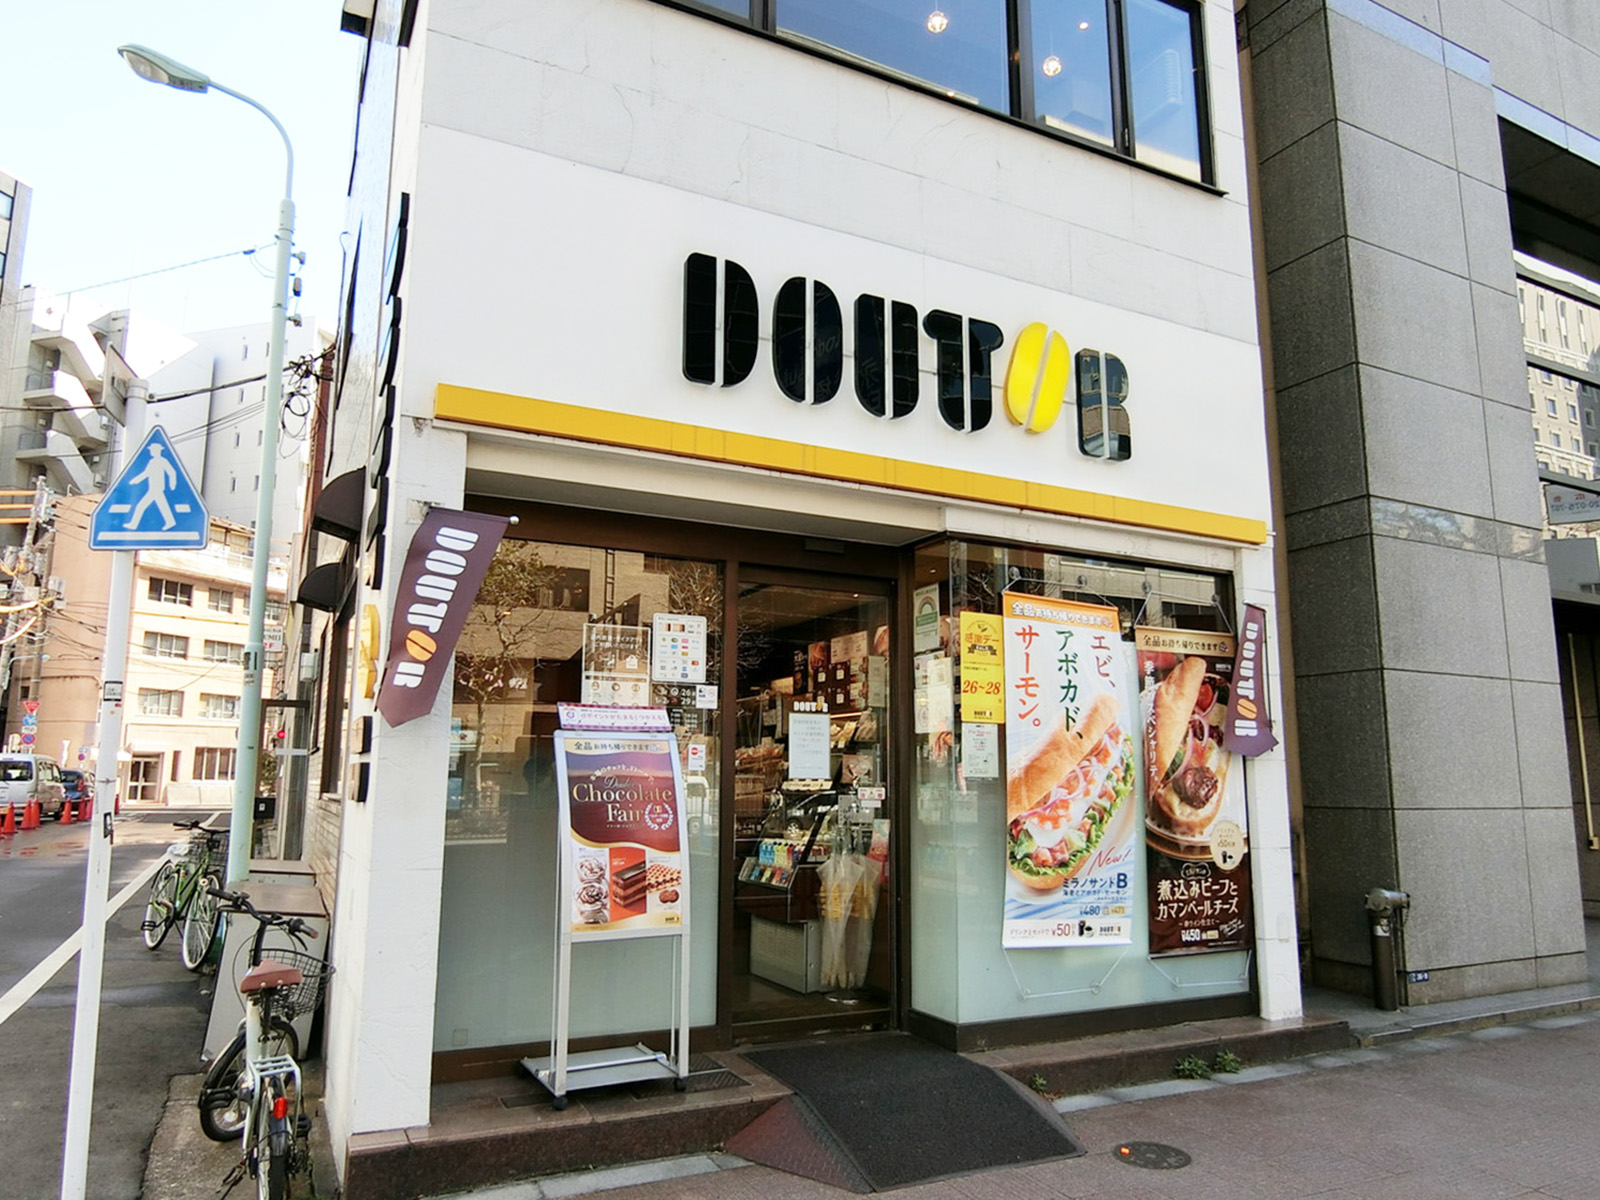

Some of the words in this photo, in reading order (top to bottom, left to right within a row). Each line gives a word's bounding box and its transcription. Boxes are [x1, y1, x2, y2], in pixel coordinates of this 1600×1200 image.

[682, 252, 1133, 462] DOUTOR
[393, 526, 479, 688] DOUTOR
[1143, 634, 1218, 652] 全品お持ち帰りできます
[1091, 635, 1116, 688] エビ、
[1014, 625, 1041, 727] サーモン。
[1056, 630, 1083, 740] アボカド、
[1234, 621, 1259, 737] DOUTOR
[793, 701, 828, 713] DOUTOR
[572, 783, 673, 802] Chocolate
[606, 803, 645, 822] Fair
[1087, 846, 1131, 876] New!
[1062, 872, 1128, 889] ミラノサンドB
[1157, 878, 1238, 902] 煮込みビーフと
[1155, 896, 1238, 921] カマンベールチーズ
